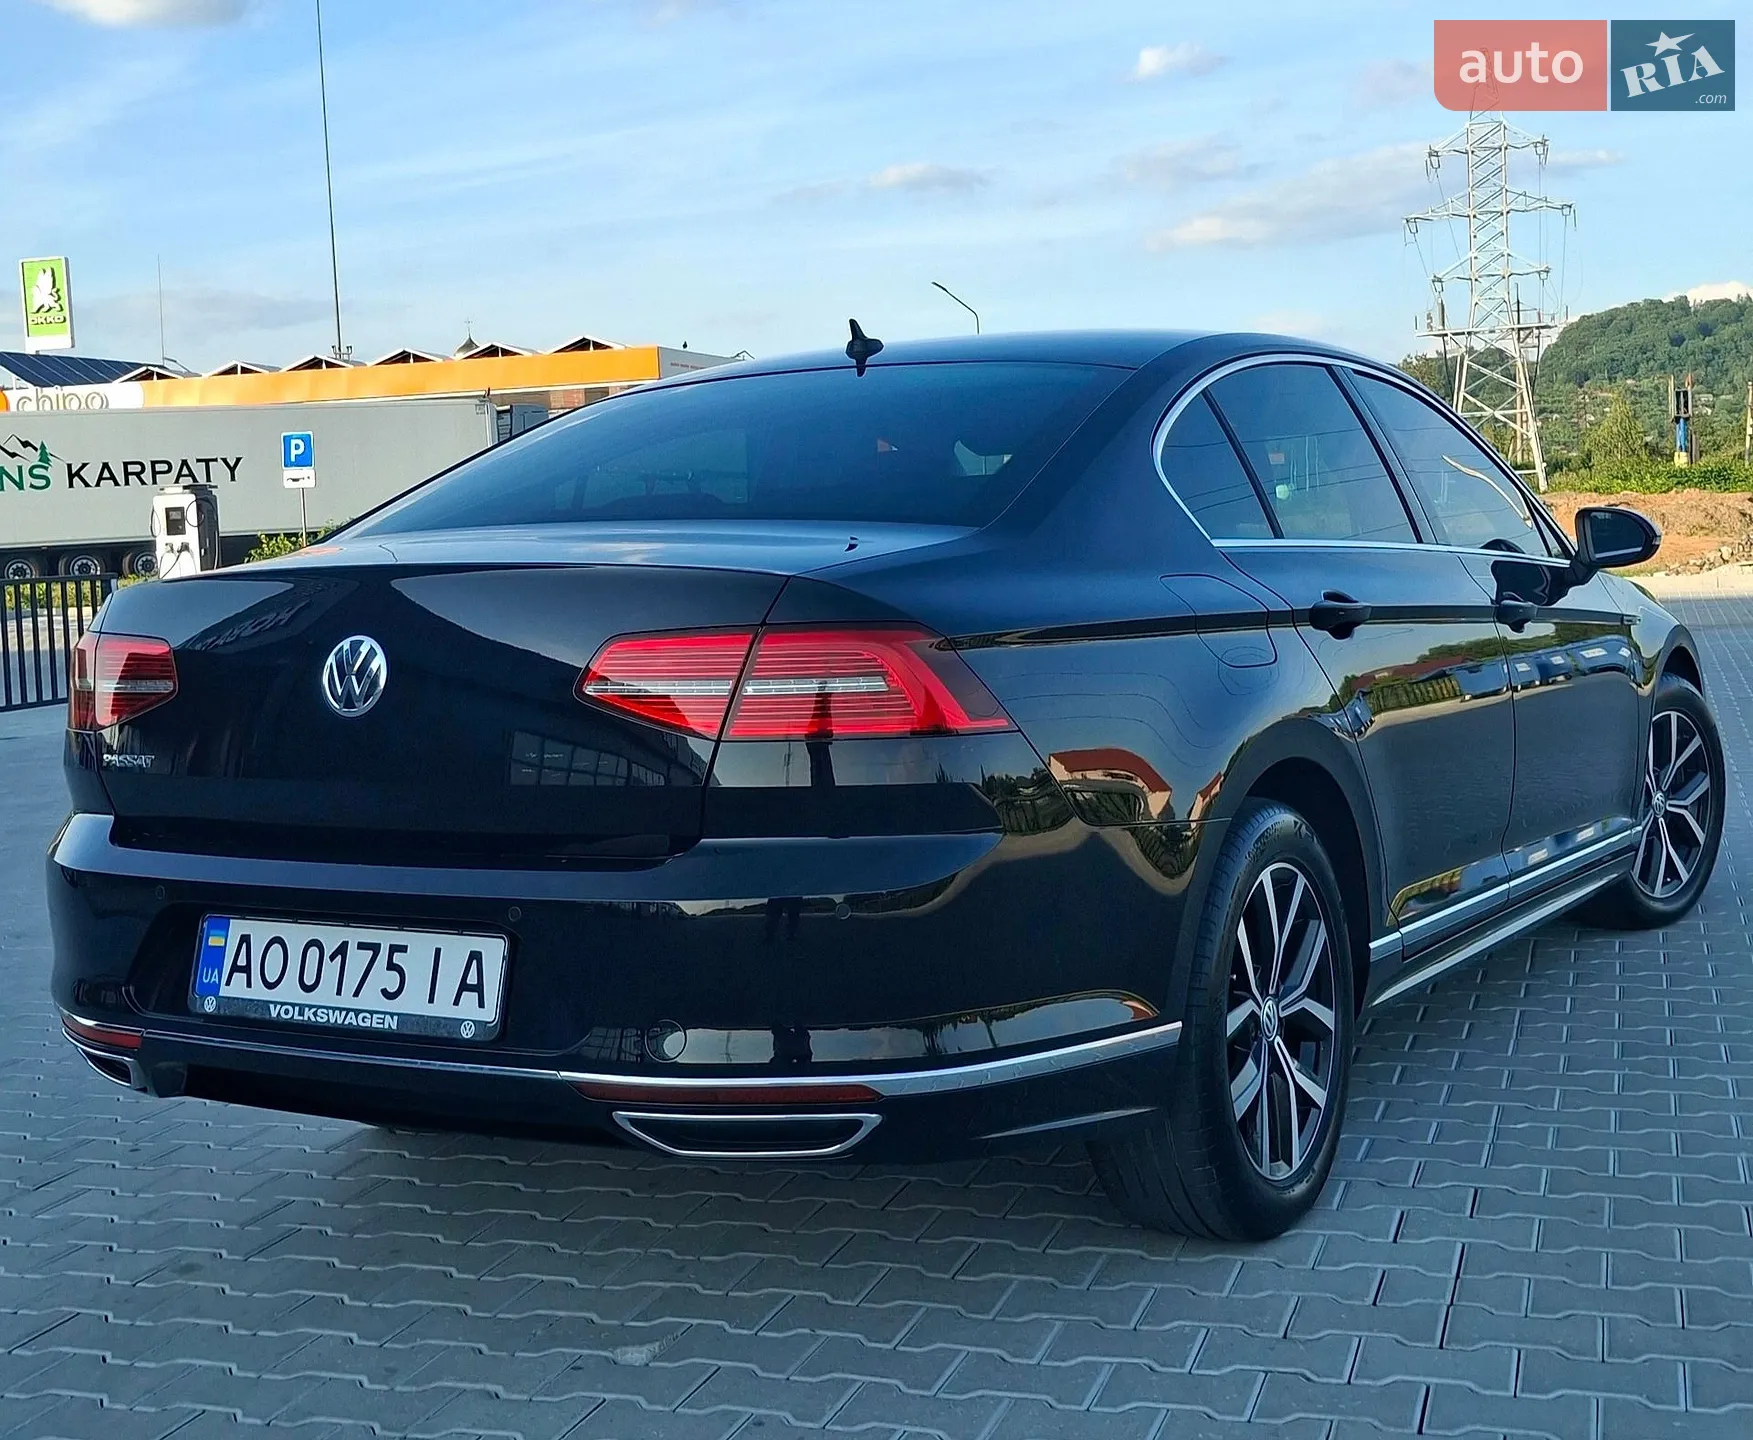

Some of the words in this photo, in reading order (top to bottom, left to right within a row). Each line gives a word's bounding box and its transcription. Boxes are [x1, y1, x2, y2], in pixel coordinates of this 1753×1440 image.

[29, 315, 66, 325] OKKO
[290, 438, 305, 462] P
[65, 456, 243, 489] KARPATY
[103, 754, 155, 768] PASSAT
[202, 968, 219, 985] UA
[298, 938, 409, 1001] 0175
[269, 1003, 399, 1030] VOLKSWAGEN
